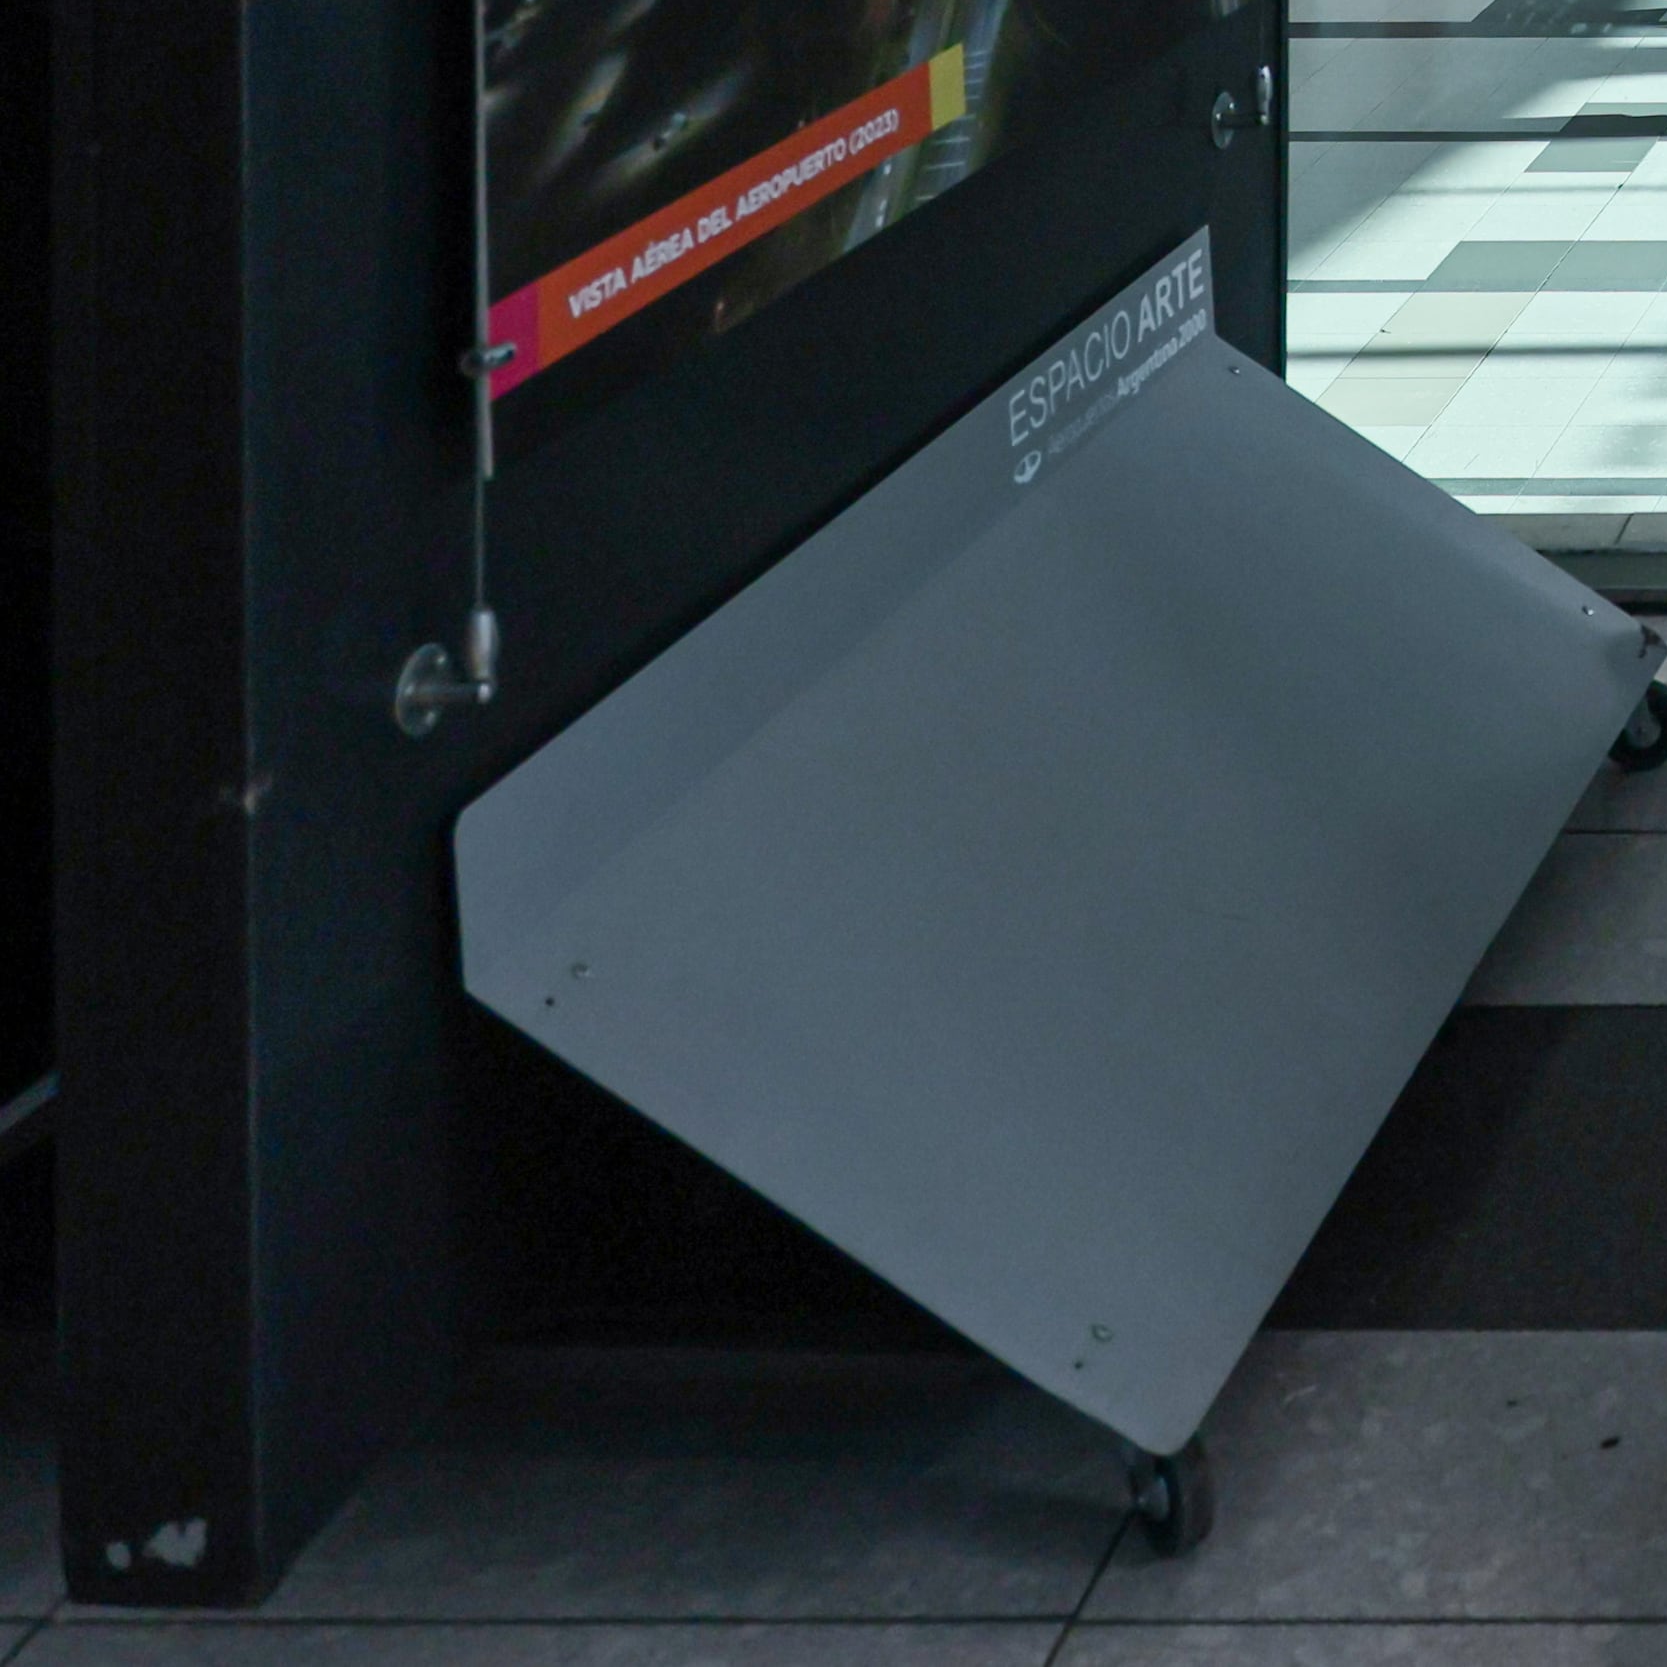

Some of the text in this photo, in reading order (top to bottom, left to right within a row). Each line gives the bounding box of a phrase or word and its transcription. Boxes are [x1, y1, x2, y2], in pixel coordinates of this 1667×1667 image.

[568, 267, 628, 319] VISTA
[630, 227, 695, 284] AÉREA
[696, 206, 733, 245] DEL
[735, 137, 848, 228] AEROPUERTO
[1009, 309, 1133, 447] ESPACIO
[1136, 247, 1206, 347] ARTE
